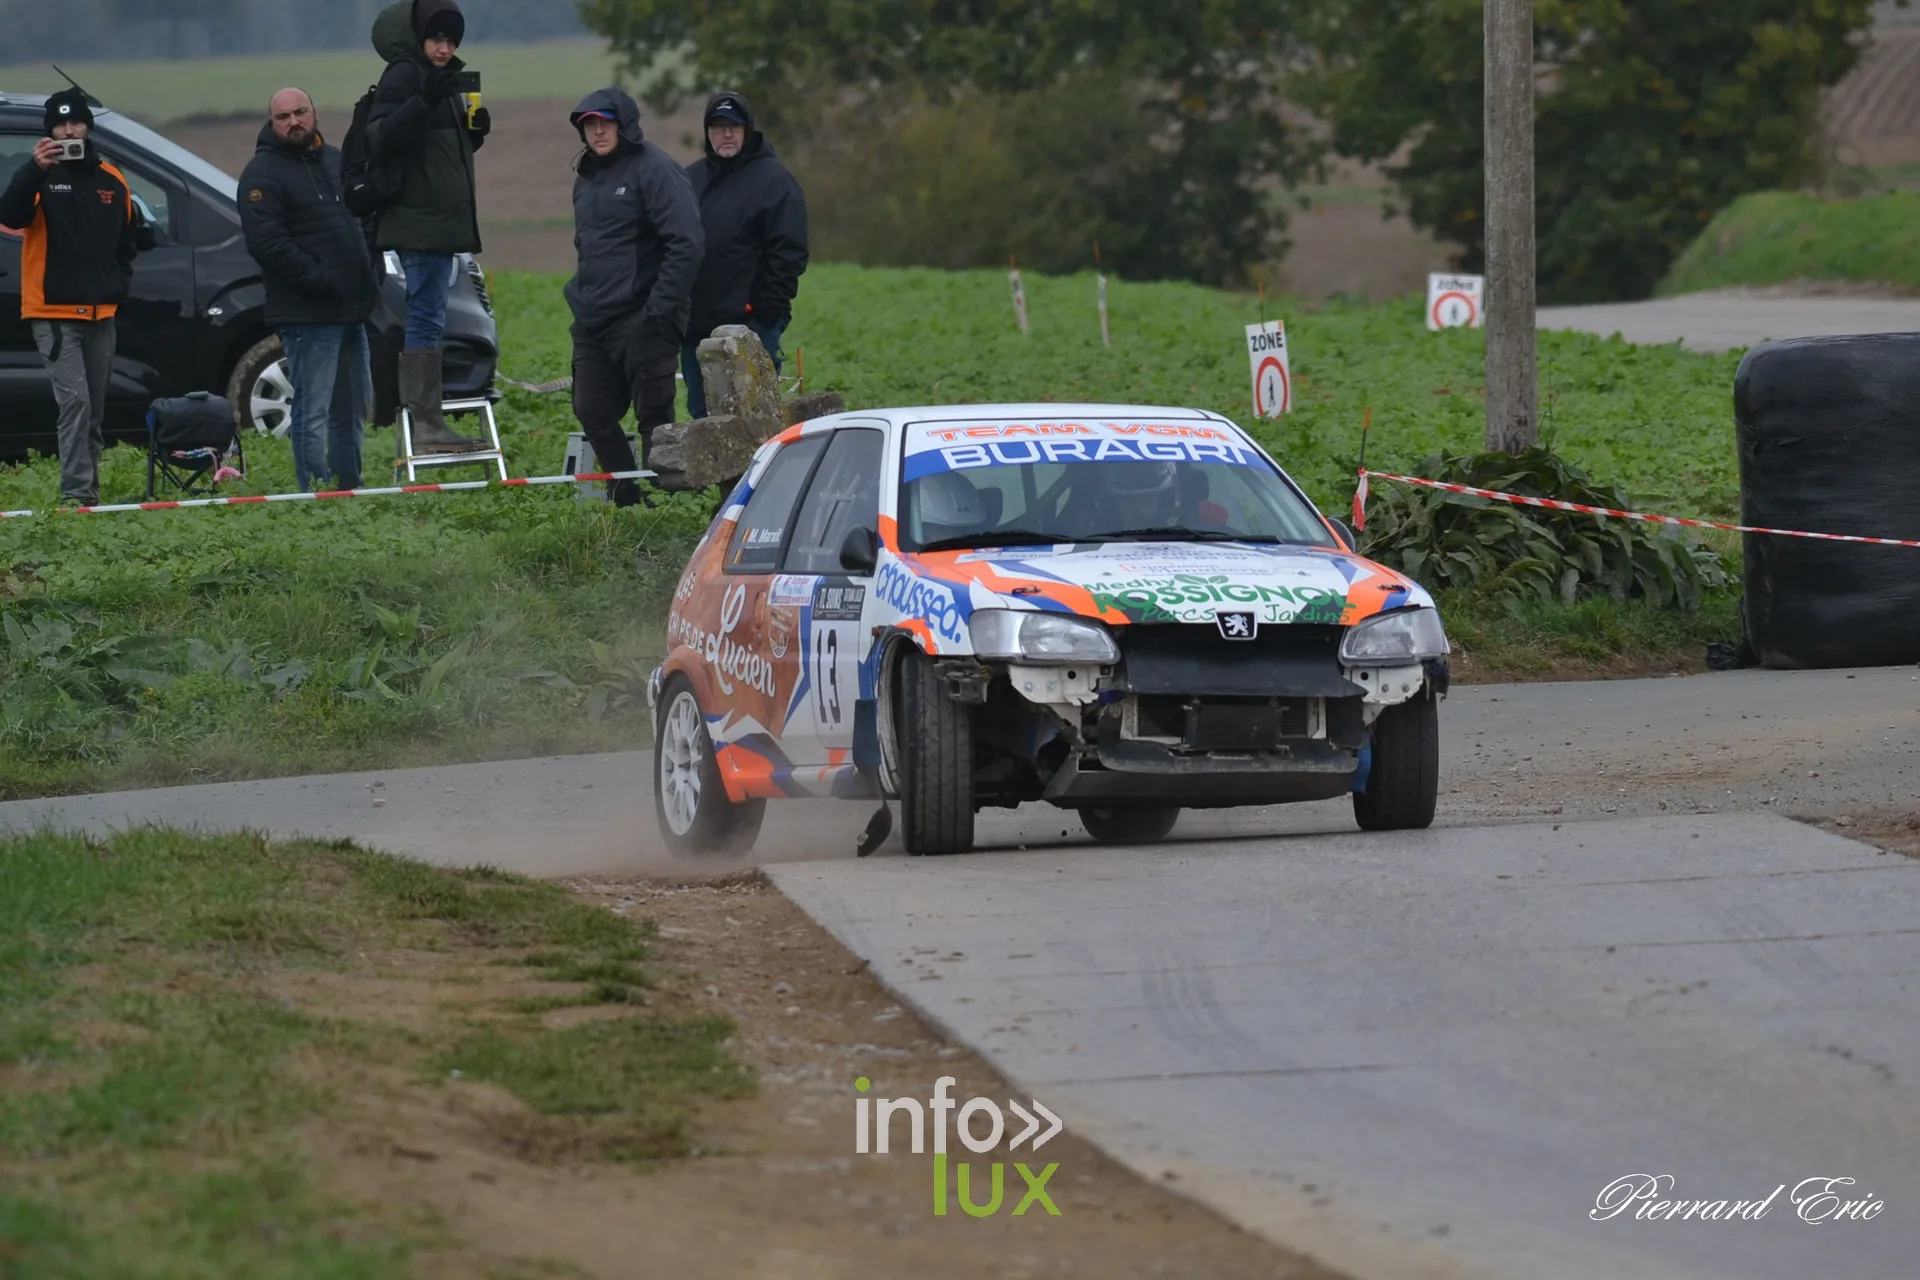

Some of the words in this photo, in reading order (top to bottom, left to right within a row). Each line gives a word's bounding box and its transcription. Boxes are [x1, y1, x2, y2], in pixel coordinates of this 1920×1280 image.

[1251, 331, 1284, 352] ZONE
[926, 422, 1098, 442] TEAM
[1100, 422, 1235, 443] VGM
[940, 438, 1248, 470] BURAGRI
[1082, 578, 1176, 593] Medhy
[1091, 584, 1357, 614] ROSSIGNOL
[1140, 605, 1217, 621] Parcs
[1263, 604, 1351, 623] Jardins
[687, 627, 706, 655] DE
[817, 628, 842, 724] 13
